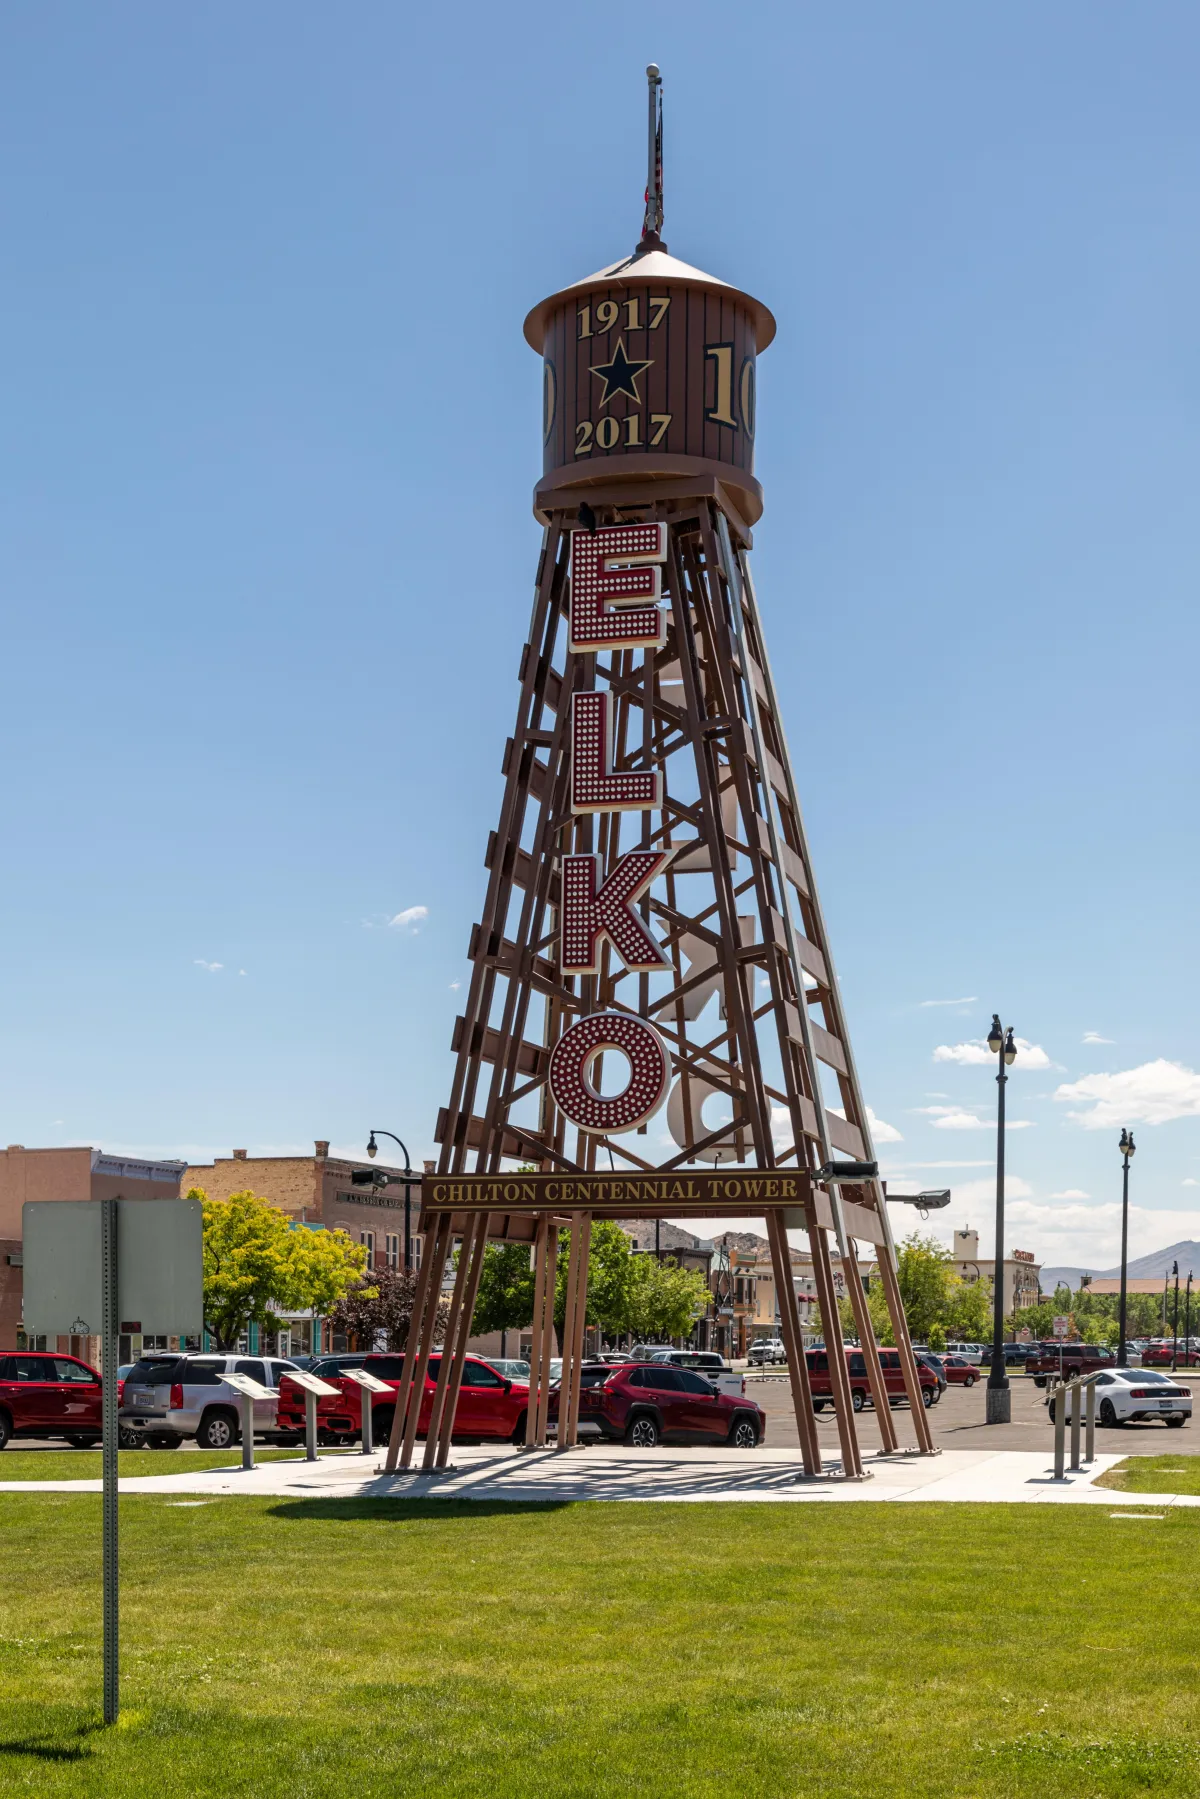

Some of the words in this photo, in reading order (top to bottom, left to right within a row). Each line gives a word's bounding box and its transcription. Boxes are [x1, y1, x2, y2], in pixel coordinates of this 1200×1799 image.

[577, 296, 672, 340] 1917
[574, 413, 673, 456] 2017
[549, 522, 676, 1135] ELKO
[432, 1183, 538, 1202] CHILTON
[545, 1181, 700, 1201] CENTENNIAL
[707, 1179, 798, 1199] TOWER
